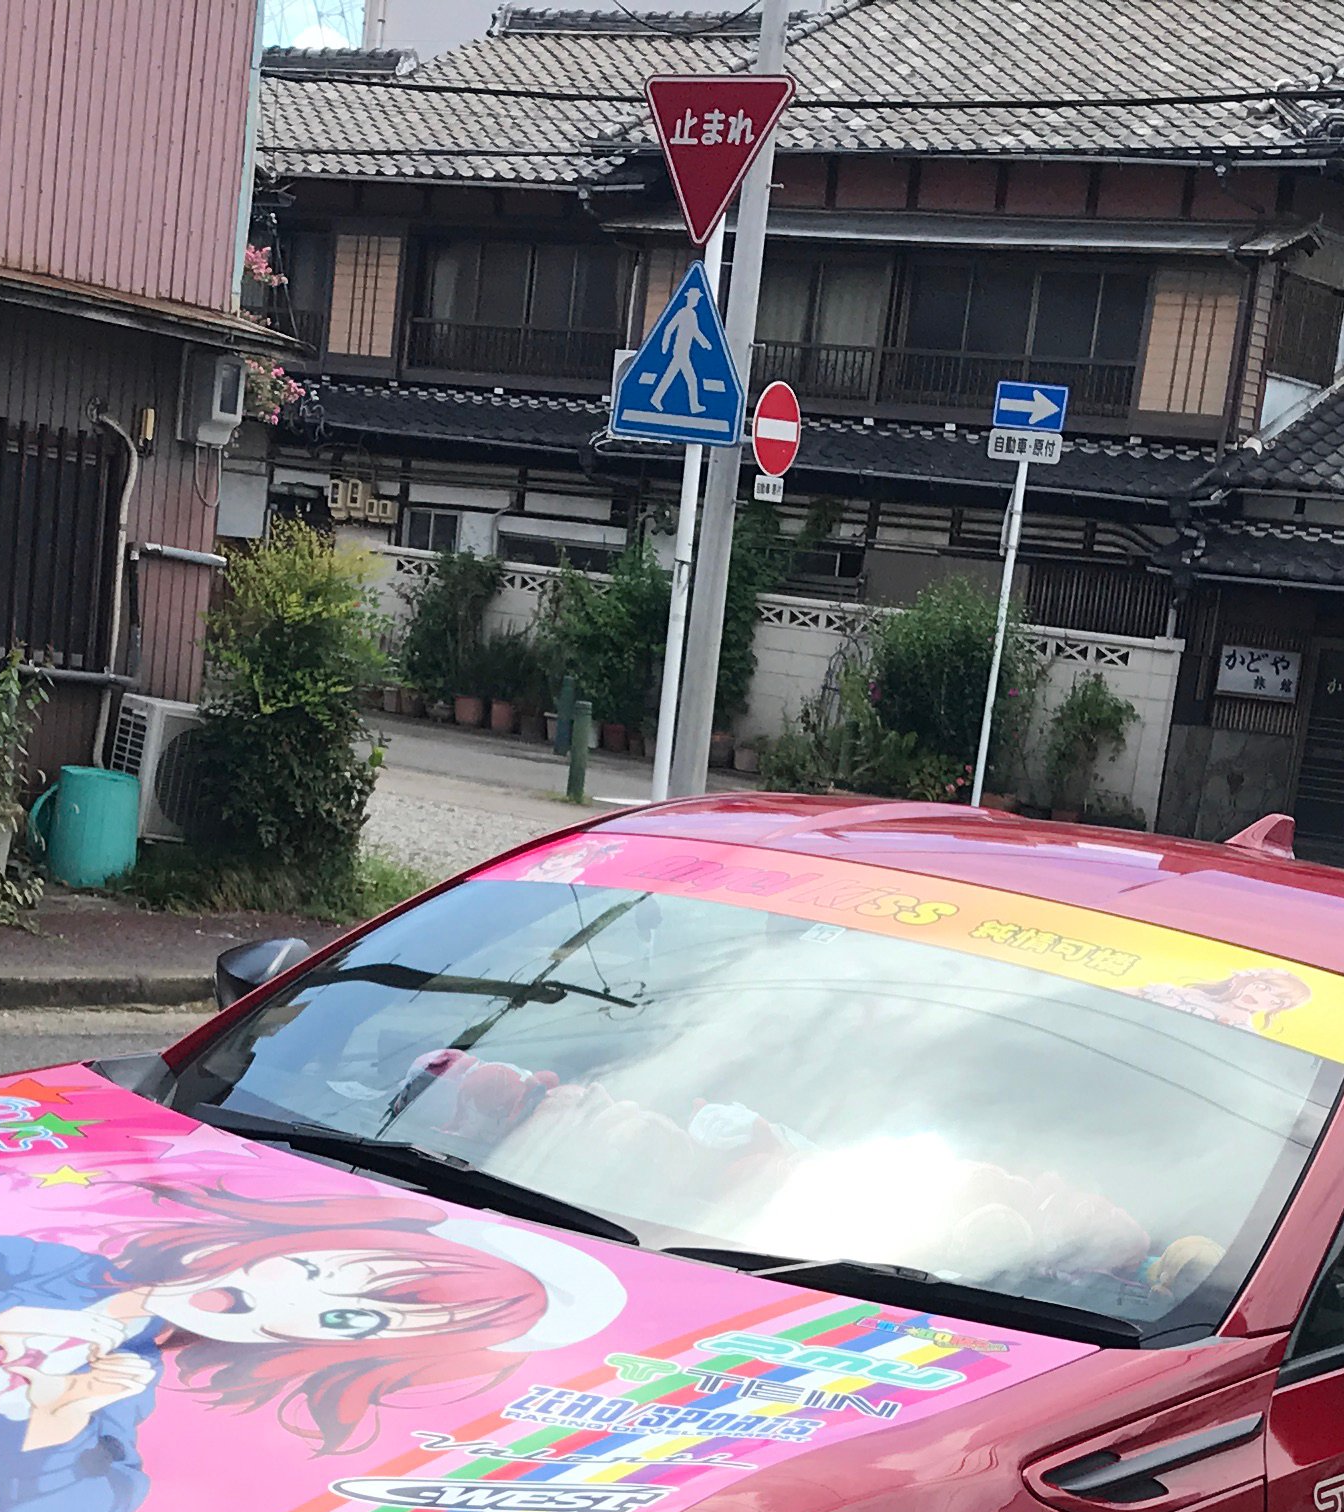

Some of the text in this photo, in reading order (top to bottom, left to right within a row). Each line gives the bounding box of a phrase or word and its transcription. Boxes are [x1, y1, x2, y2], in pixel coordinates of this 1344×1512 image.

[669, 108, 755, 145] 止まれ
[1224, 649, 1290, 675] かどや
[684, 1367, 901, 1419] TEIN
[503, 1410, 812, 1442] RACING DEVELOPMENT
